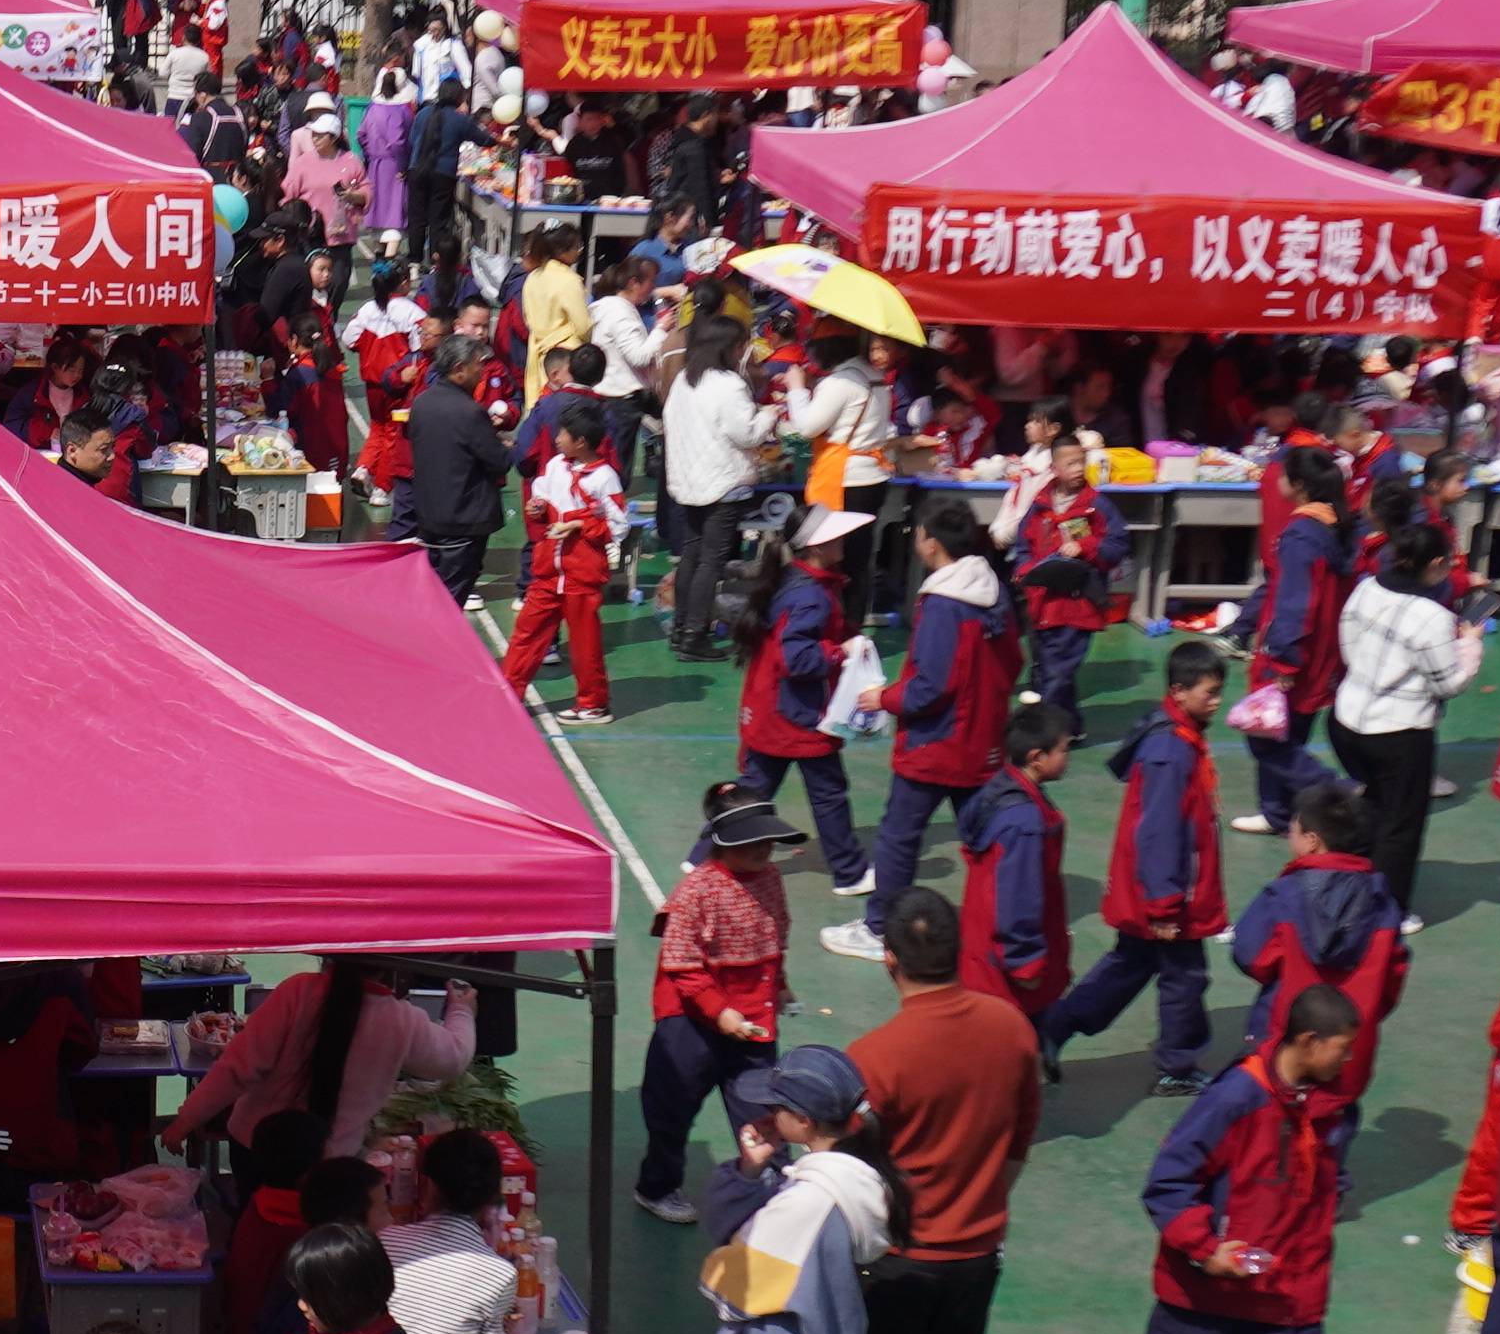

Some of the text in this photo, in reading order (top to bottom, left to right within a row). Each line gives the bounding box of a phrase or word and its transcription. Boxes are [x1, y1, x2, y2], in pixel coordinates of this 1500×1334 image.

[558, 11, 906, 80] 义卖无大小 爱心价更高
